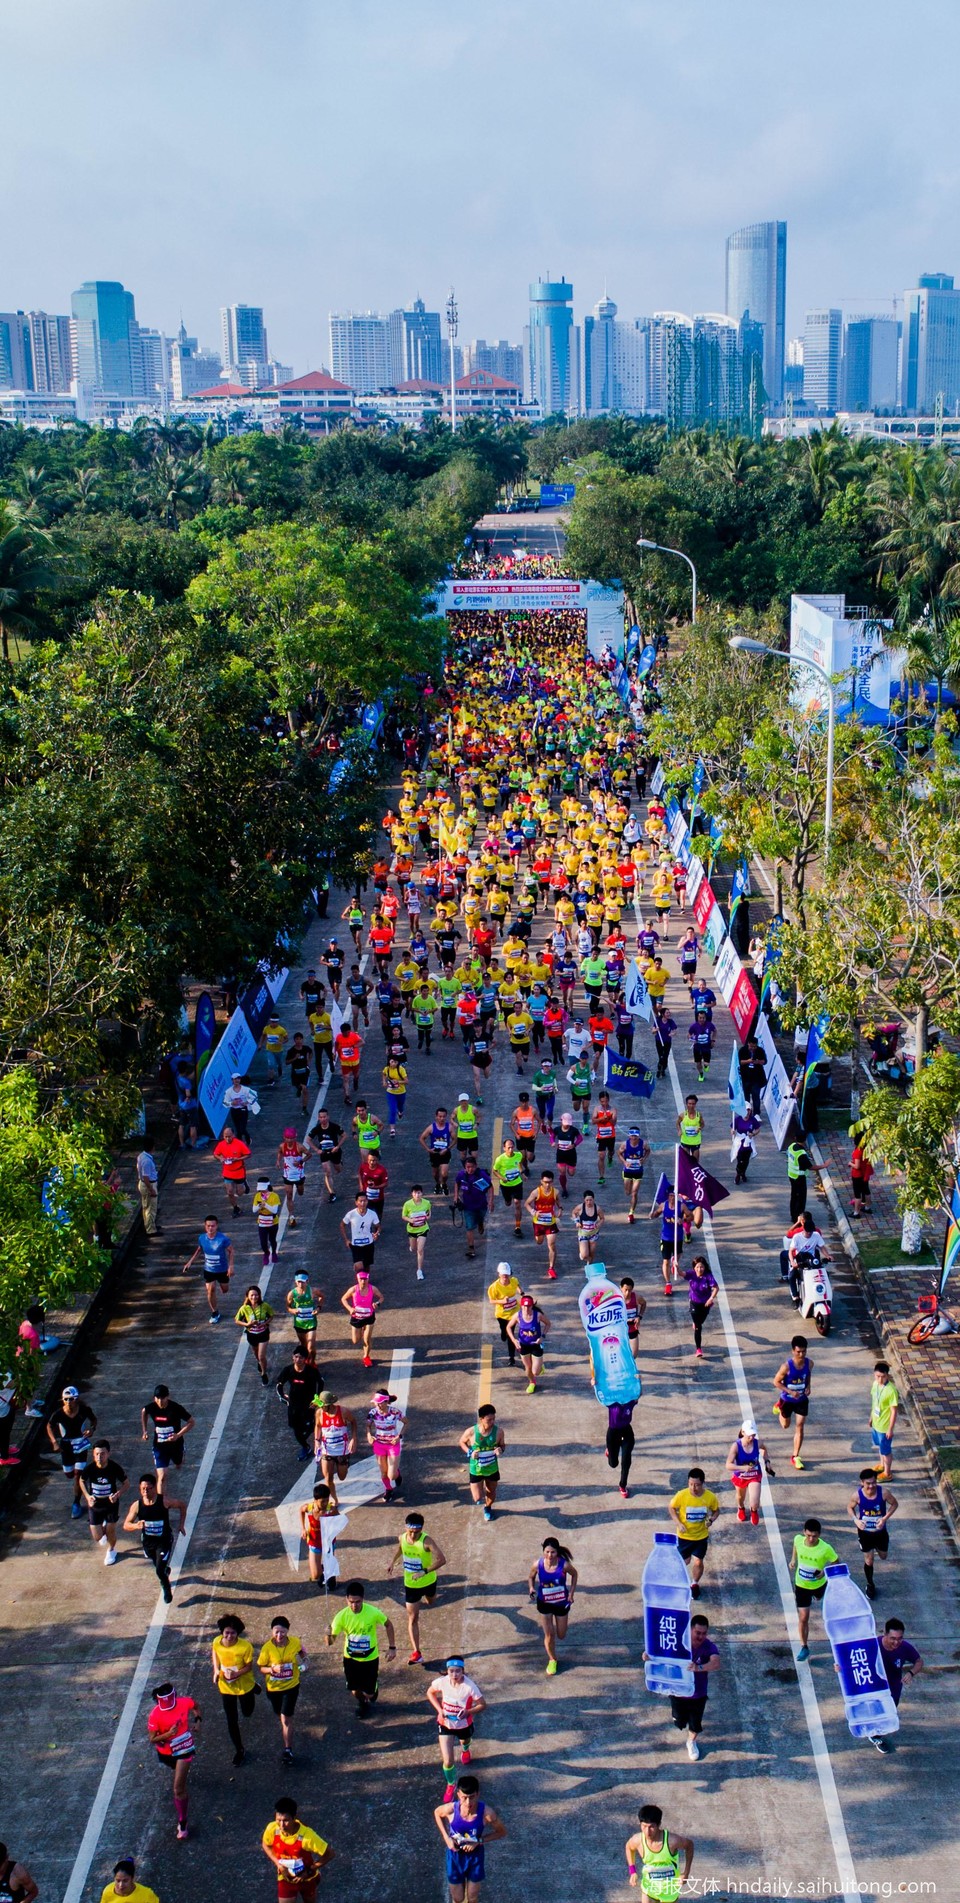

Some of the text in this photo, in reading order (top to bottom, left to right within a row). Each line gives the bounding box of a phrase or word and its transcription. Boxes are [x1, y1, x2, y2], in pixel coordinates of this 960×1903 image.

[496, 595, 520, 607] 2018
[587, 1307, 623, 1325] 水动乐
[659, 1615, 678, 1651] 纯悦
[850, 1648, 874, 1686] 纯悦
